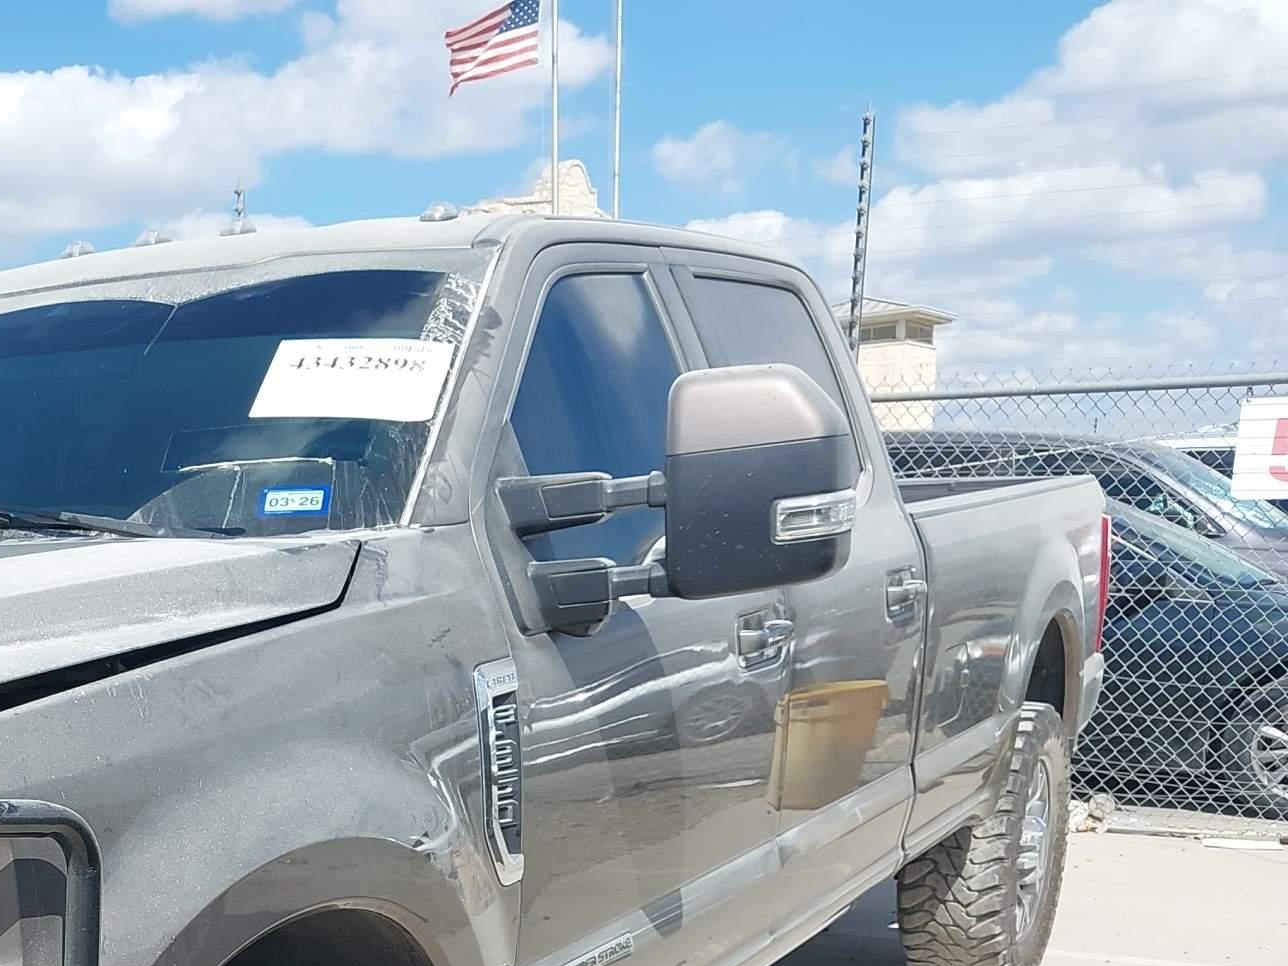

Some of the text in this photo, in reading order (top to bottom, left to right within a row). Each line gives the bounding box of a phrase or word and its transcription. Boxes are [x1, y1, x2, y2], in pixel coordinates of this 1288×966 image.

[289, 355, 427, 372] 43432898
[269, 496, 320, 507] 03 26
